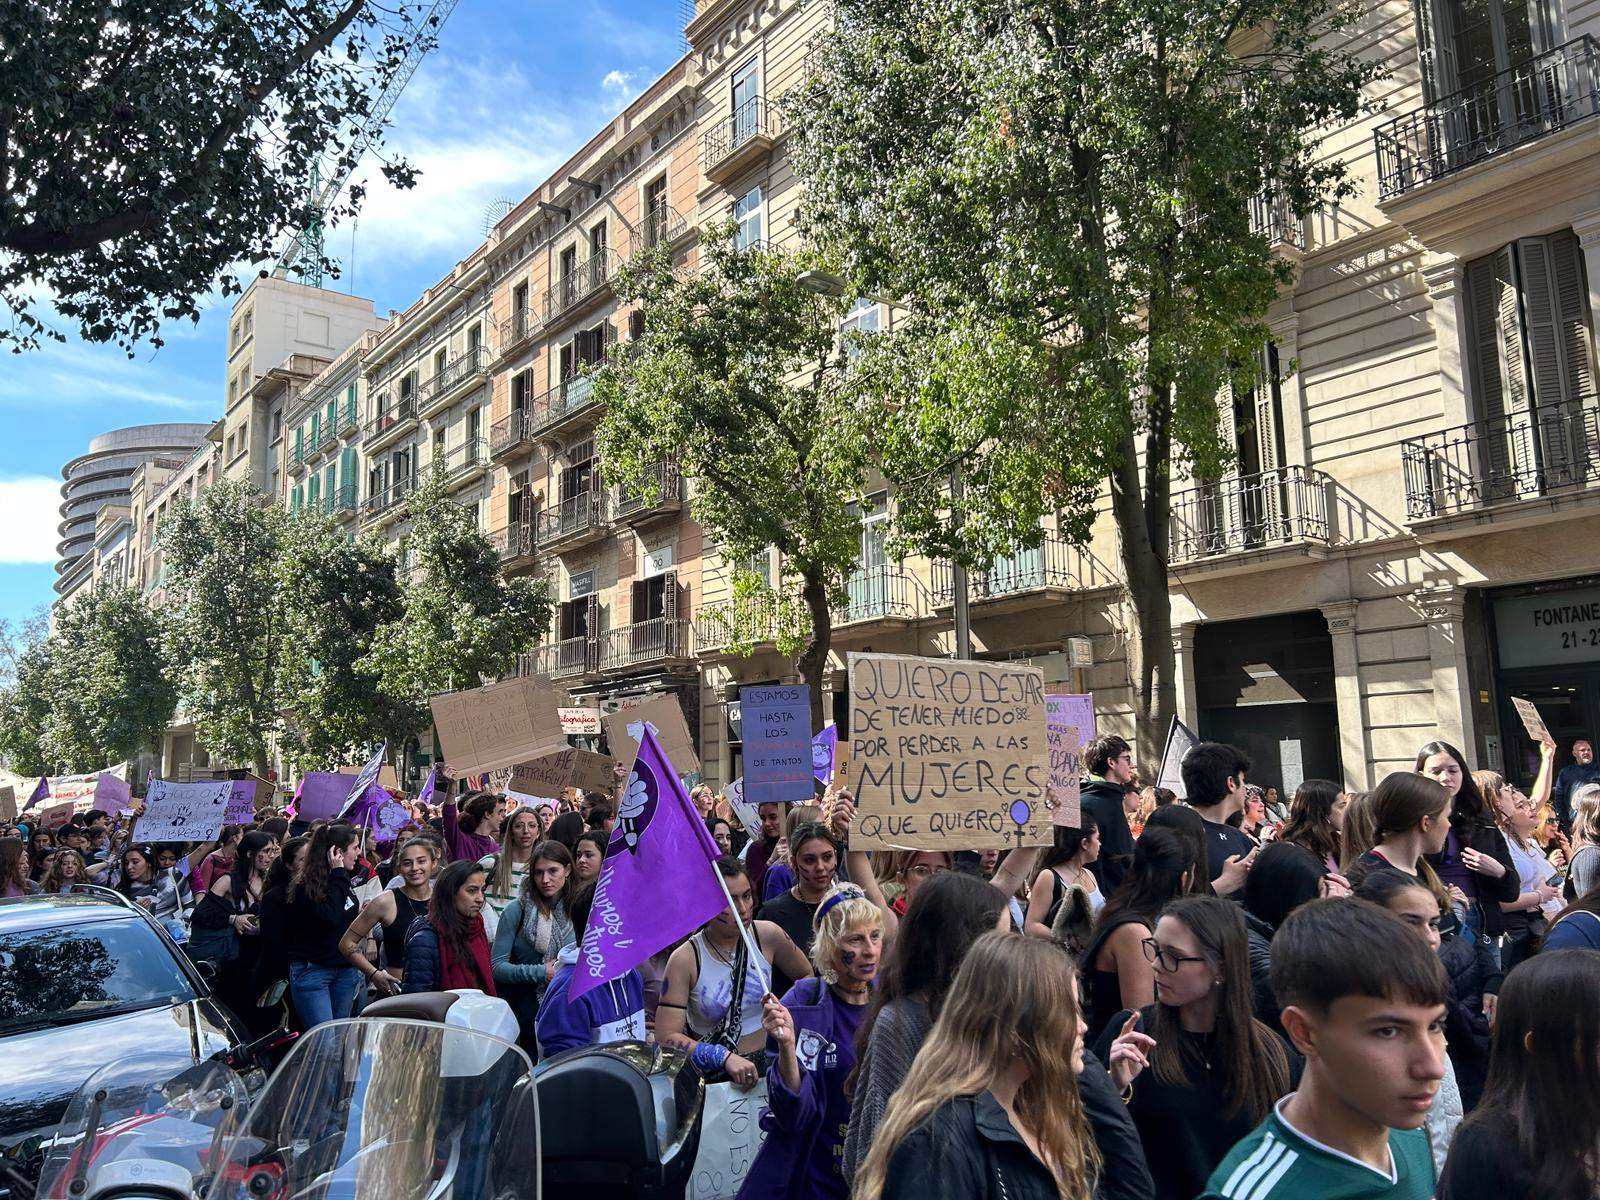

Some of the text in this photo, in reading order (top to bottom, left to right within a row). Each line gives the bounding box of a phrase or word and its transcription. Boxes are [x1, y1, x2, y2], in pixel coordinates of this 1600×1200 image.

[853, 658, 1044, 706] QUIERO DEJAR
[749, 690, 799, 704] ESTAMOS
[759, 713, 795, 723] HASTA
[854, 704, 1016, 734] DE TENER MIEDO
[765, 728, 788, 738] LOS
[853, 735, 1029, 760] POR PERDER A LAS
[753, 758, 802, 767] DE TANTOS
[854, 761, 1042, 809] MUJERES
[860, 810, 1003, 841] QUE QUIERO
[730, 1097, 749, 1134] NO
